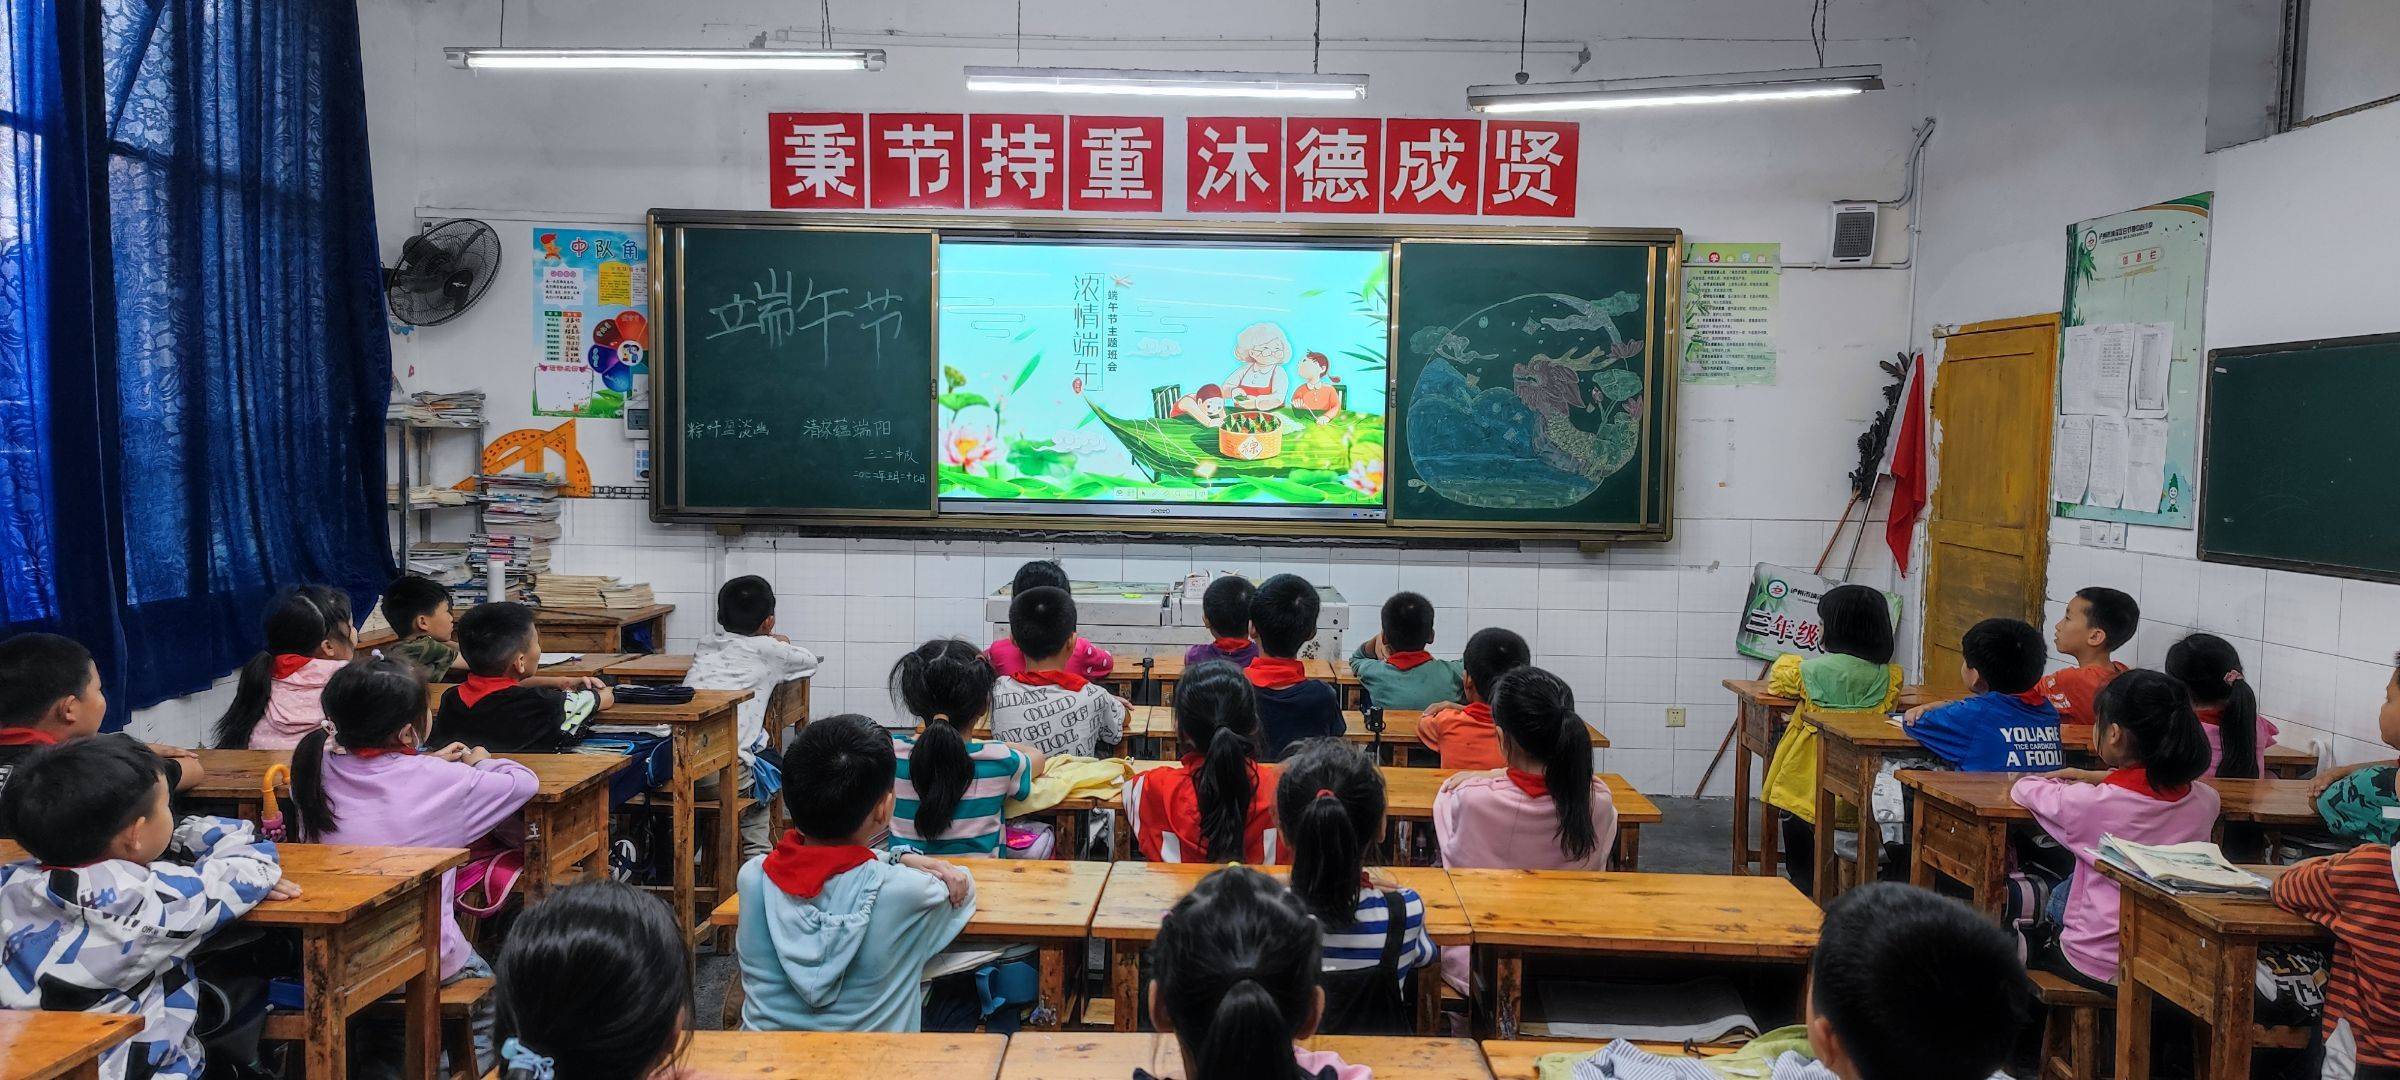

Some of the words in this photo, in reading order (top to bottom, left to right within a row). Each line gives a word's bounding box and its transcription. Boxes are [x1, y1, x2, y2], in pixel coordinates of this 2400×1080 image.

[784, 123, 1152, 200] 秉节持重
[1197, 125, 1564, 207] 沐德成贤
[570, 237, 639, 260] 中队角
[706, 267, 903, 369] 端午节
[1073, 274, 1100, 386] 浓情端午
[1107, 290, 1119, 372] 端午节主题班会
[1745, 608, 1824, 654] 三年级
[2006, 751, 2021, 767] A
